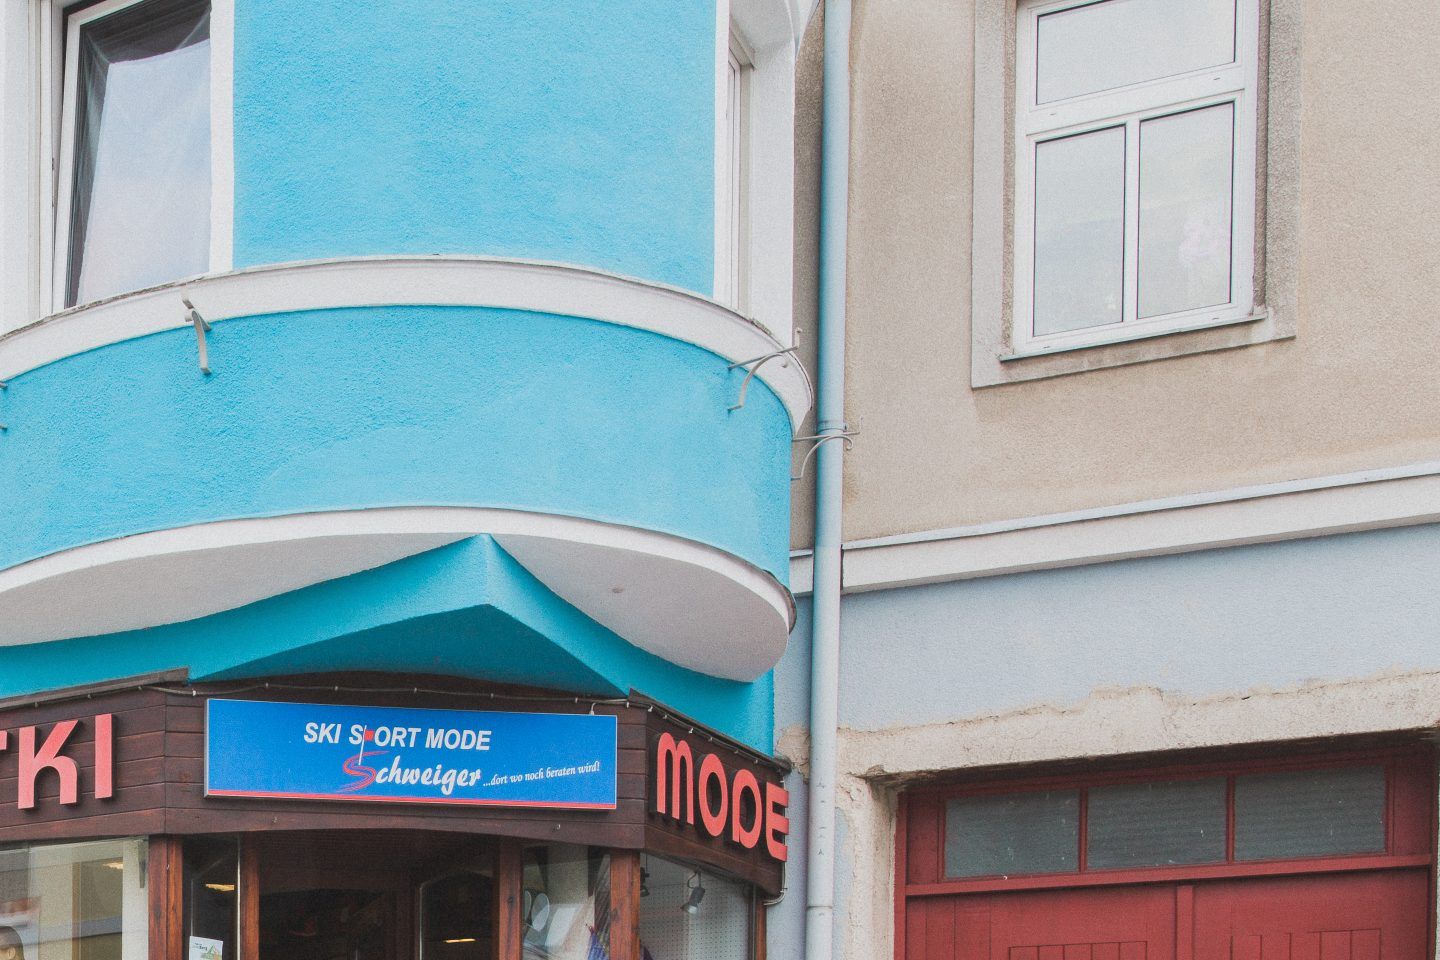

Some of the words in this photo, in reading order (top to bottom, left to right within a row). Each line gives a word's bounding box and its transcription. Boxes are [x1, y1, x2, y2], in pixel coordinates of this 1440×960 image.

[303, 722, 342, 744] SKI
[424, 728, 492, 750] MODE
[337, 750, 482, 796] Schweiger
[510, 774, 523, 783] wo
[525, 768, 544, 781] noch
[546, 767, 576, 779] beraten
[577, 761, 600, 774] wird!
[656, 732, 790, 862] MODE
